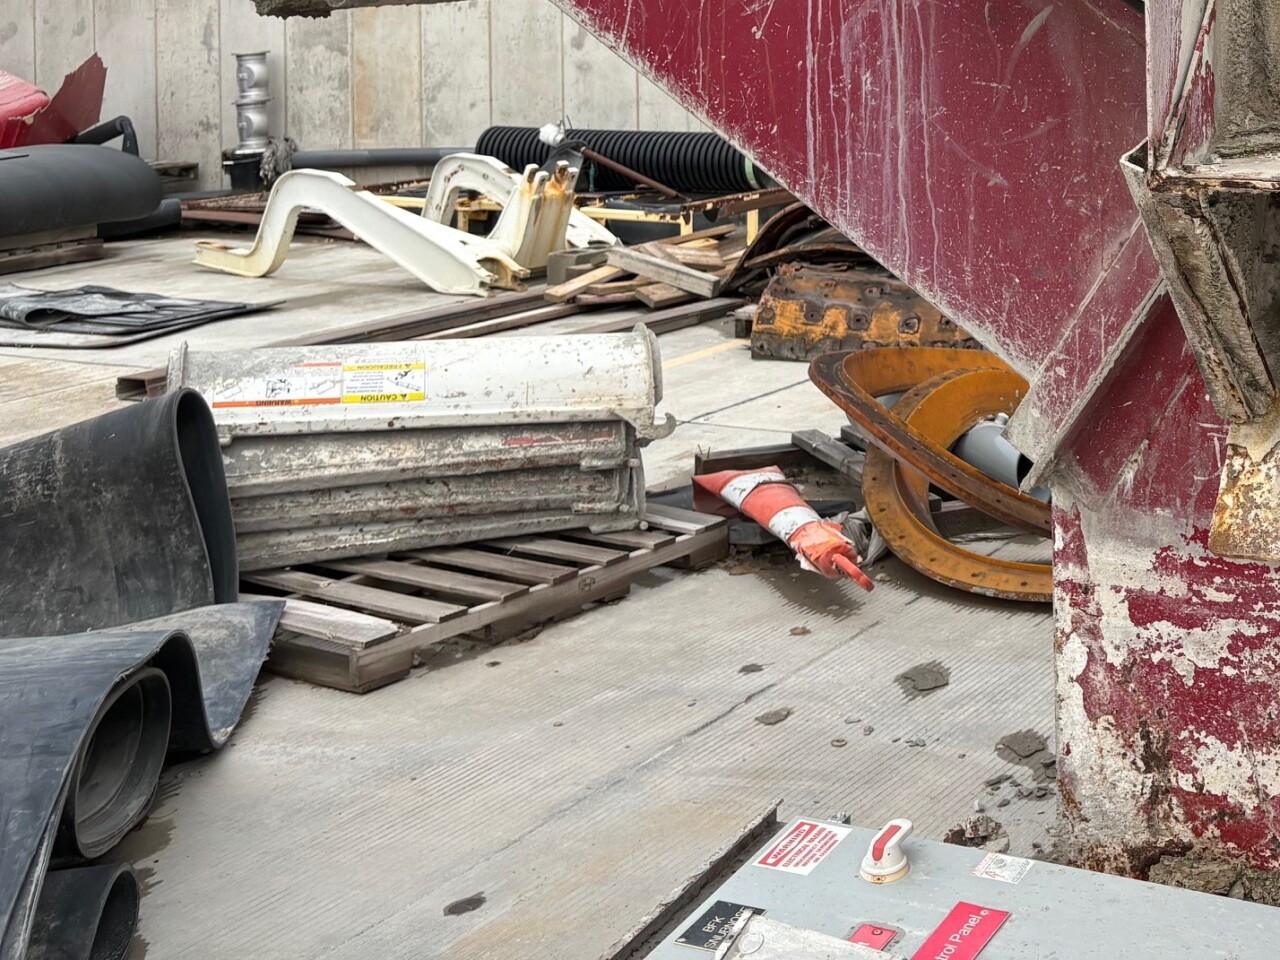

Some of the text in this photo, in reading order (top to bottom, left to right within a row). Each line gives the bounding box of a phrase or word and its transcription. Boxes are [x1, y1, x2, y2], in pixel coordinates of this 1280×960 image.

[360, 393, 398, 402] CAUTION
[771, 828, 806, 859] WARNING
[702, 915, 725, 933] BFK
[950, 914, 983, 943] Panel
